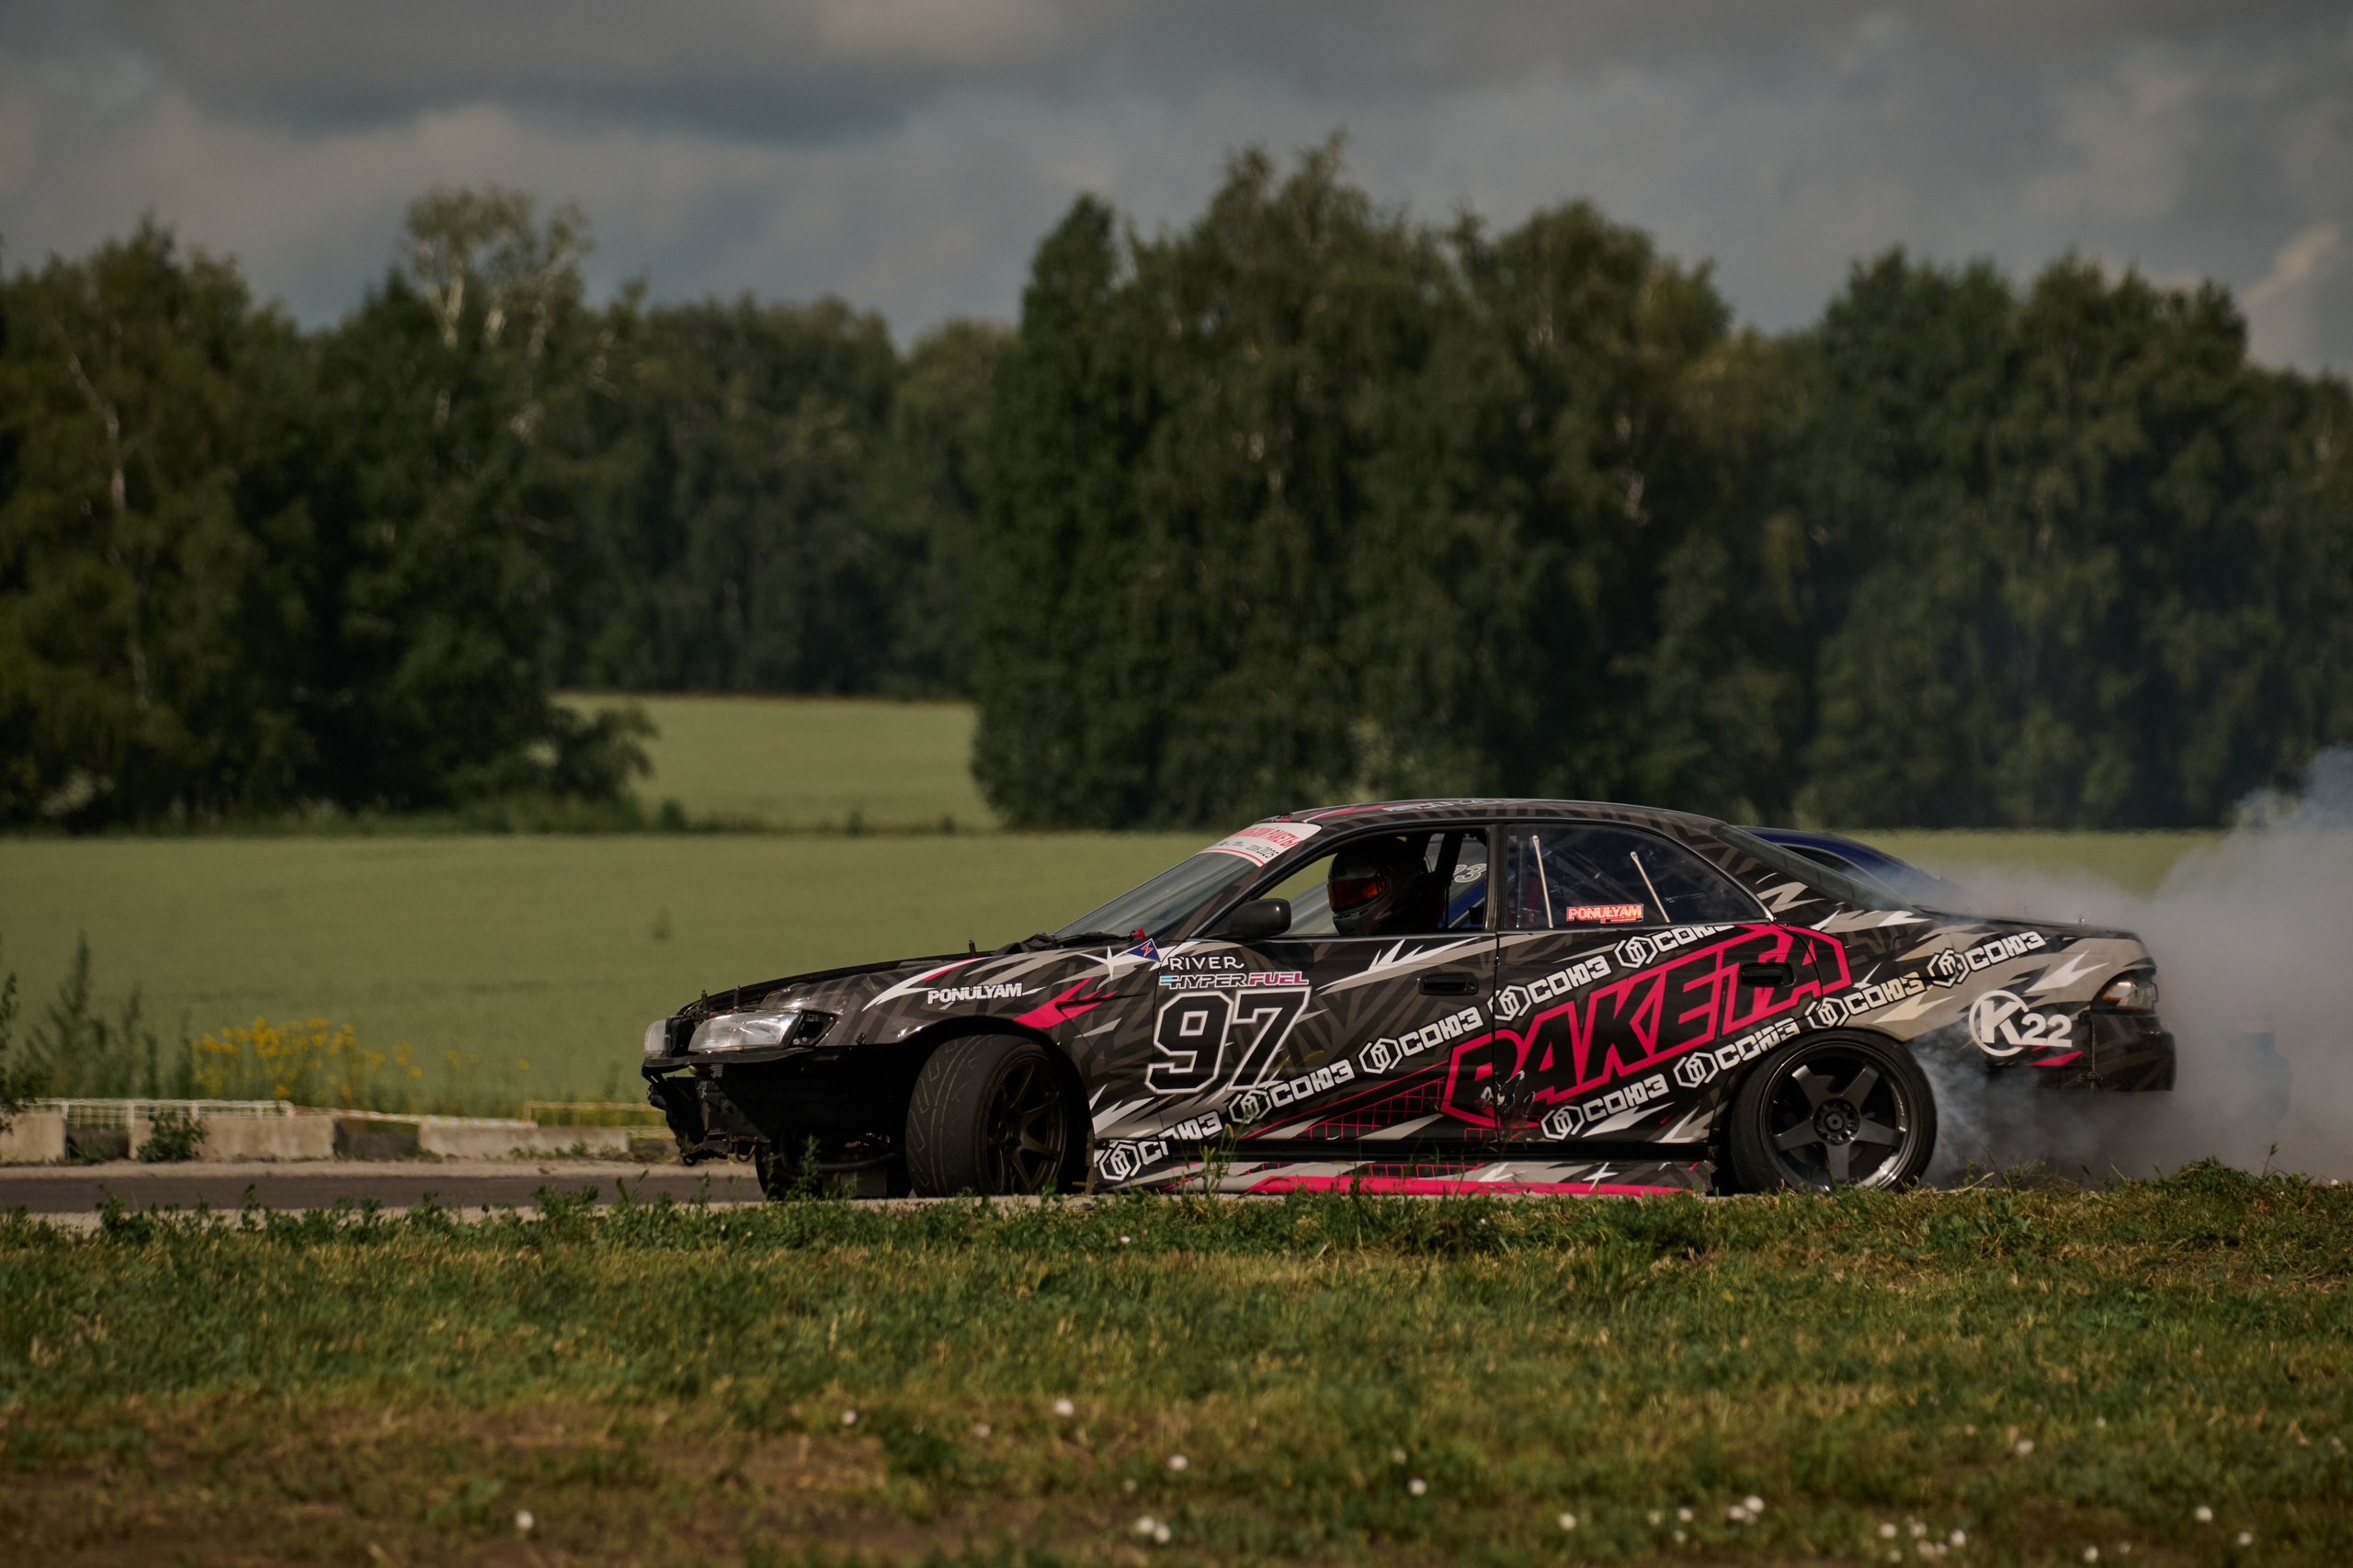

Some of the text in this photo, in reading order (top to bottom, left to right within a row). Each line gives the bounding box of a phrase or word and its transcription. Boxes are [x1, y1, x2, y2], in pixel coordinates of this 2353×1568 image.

[1567, 904, 1643, 921] PONULYAM
[1169, 955, 1245, 971] RIVER
[1966, 930, 2047, 971] СОЮЗ
[926, 983, 1023, 1005] PONULYAM
[1527, 955, 1611, 1004] СОЮЗ
[1844, 971, 1927, 1016] СОЮЗ
[1144, 985, 1312, 1095] 97
[1399, 1006, 1483, 1056] СОЮЗ
[1714, 1017, 1800, 1070] СОЮЗ
[1269, 1059, 1355, 1108] СОЮЗ
[1585, 1074, 1669, 1122] СОЮЗ
